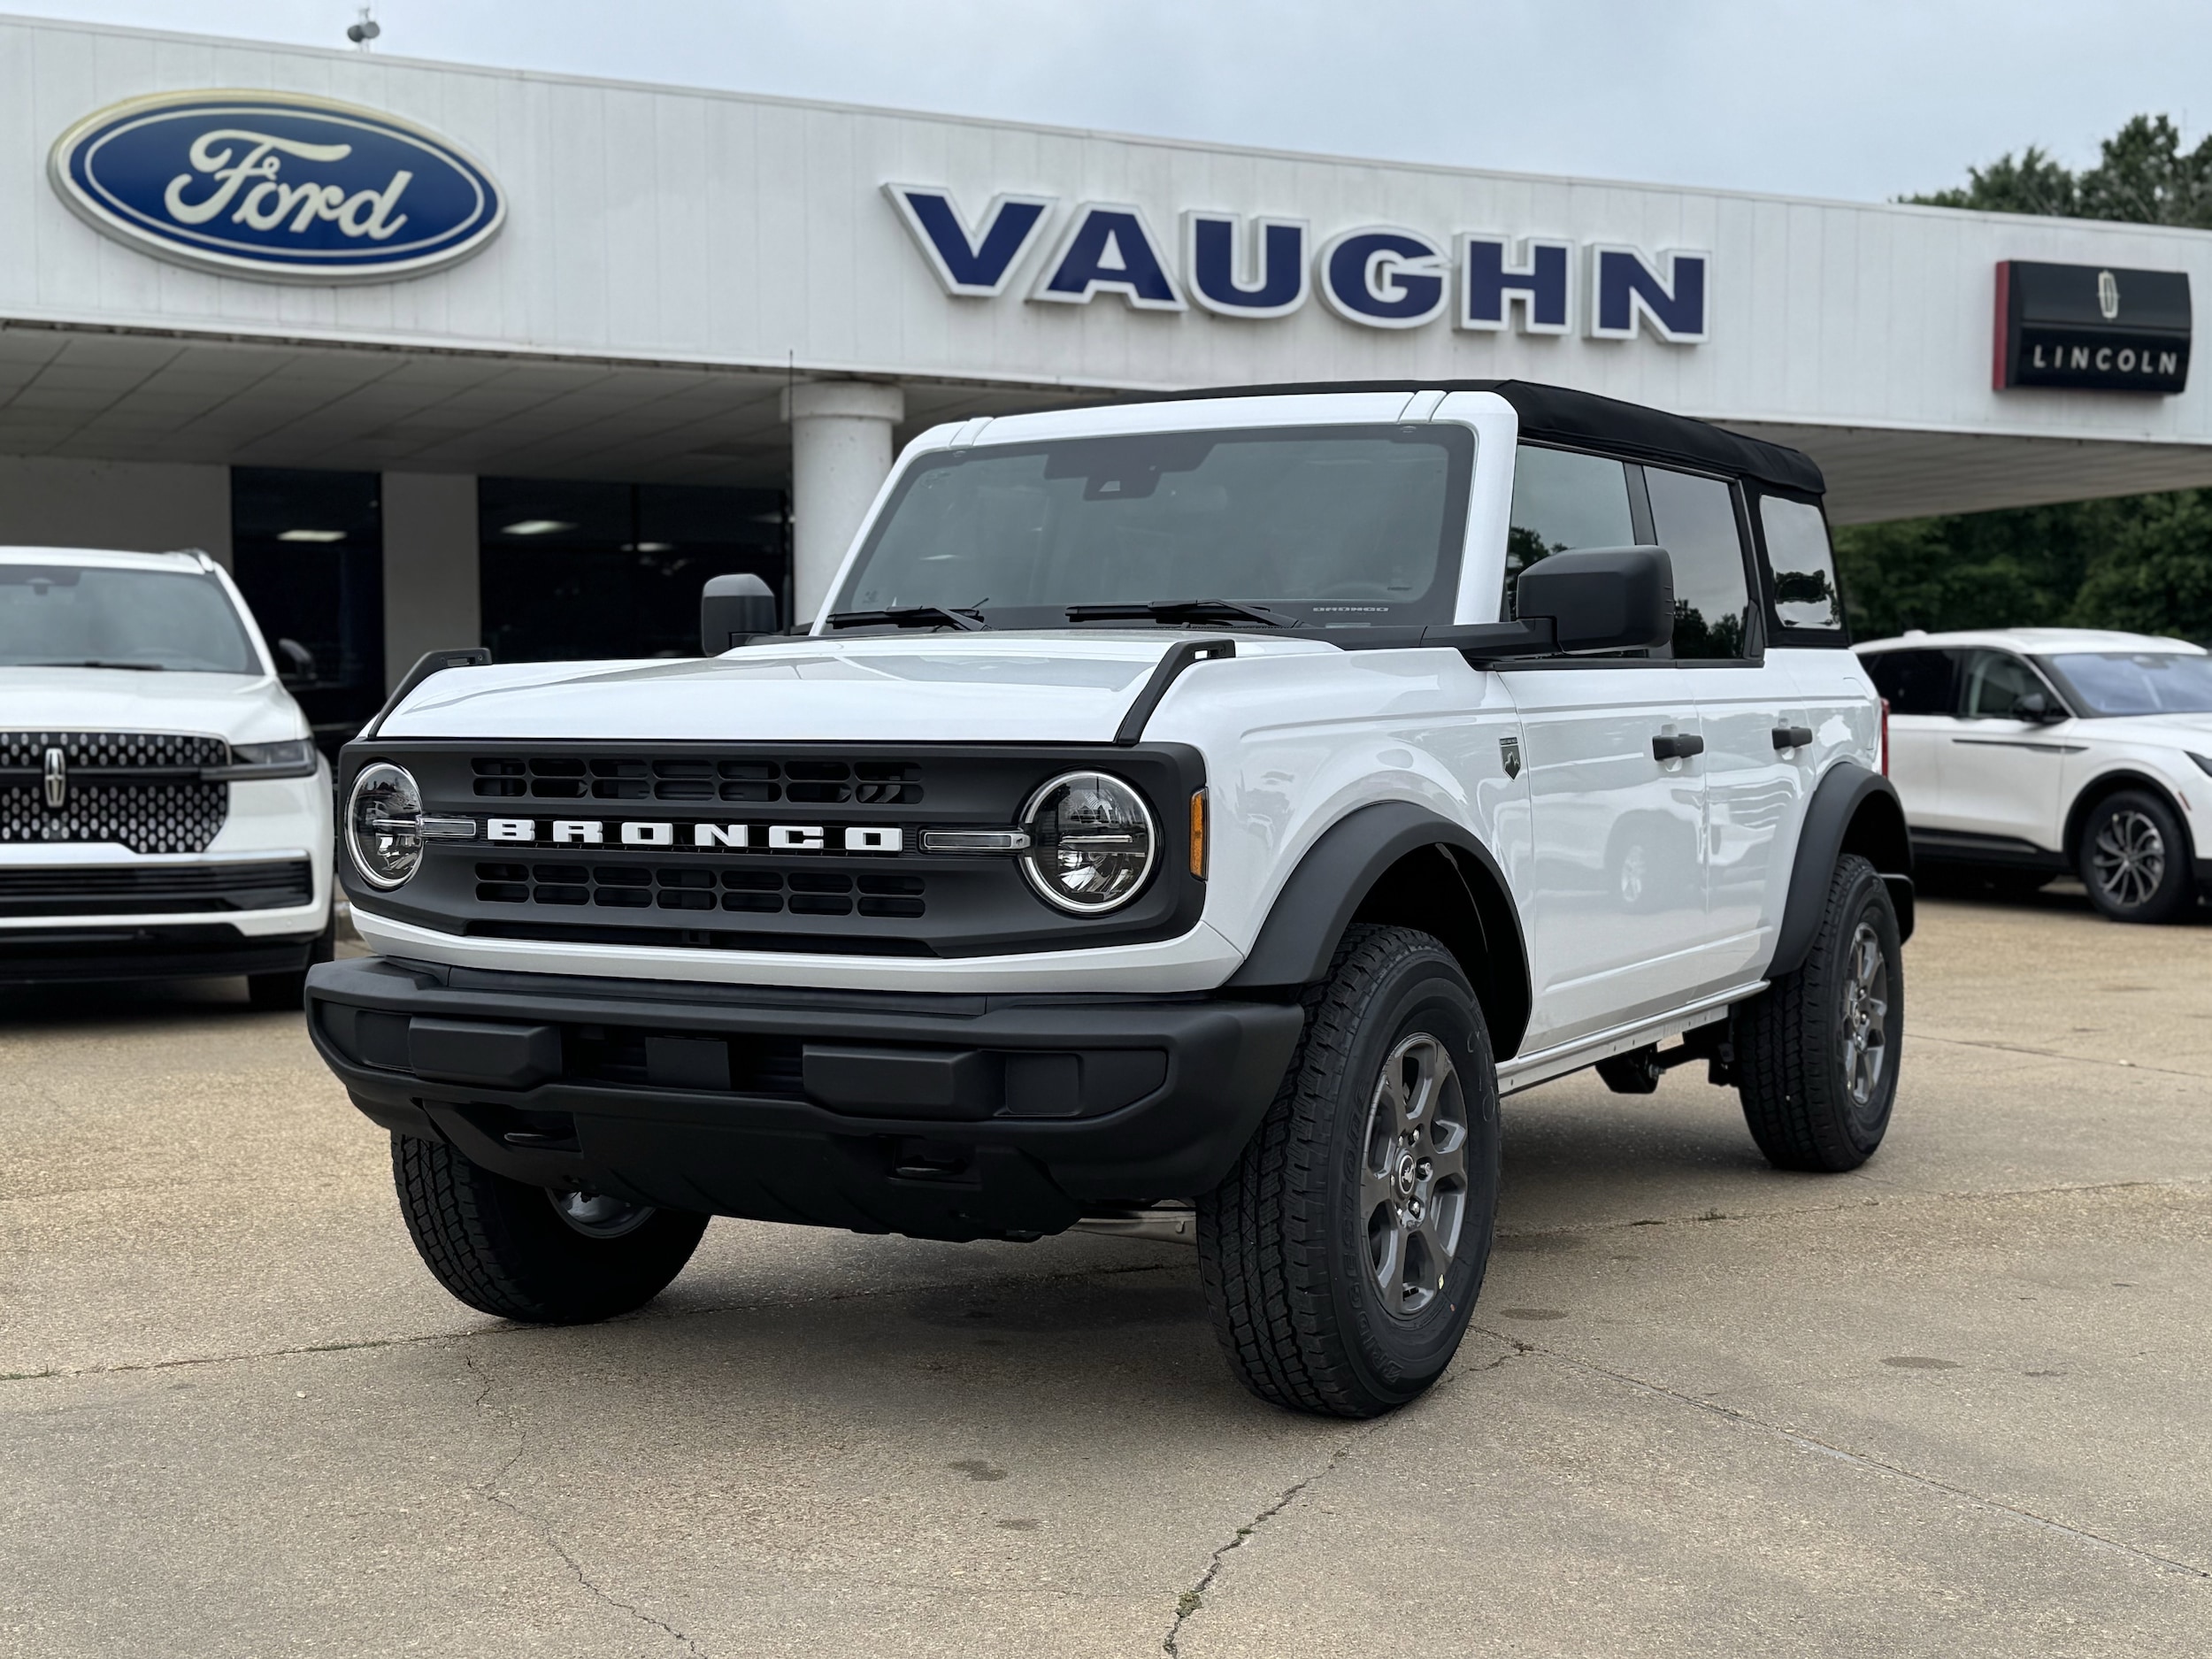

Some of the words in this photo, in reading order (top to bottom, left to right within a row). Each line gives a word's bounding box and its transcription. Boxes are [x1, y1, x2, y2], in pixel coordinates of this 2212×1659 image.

[165, 128, 413, 240] Ford
[890, 186, 1709, 340] VAUGHN
[2032, 343, 2177, 376] LINCOLN
[486, 817, 904, 852] BRONCO
[1341, 1078, 1404, 1384] BRIDGESTONE
